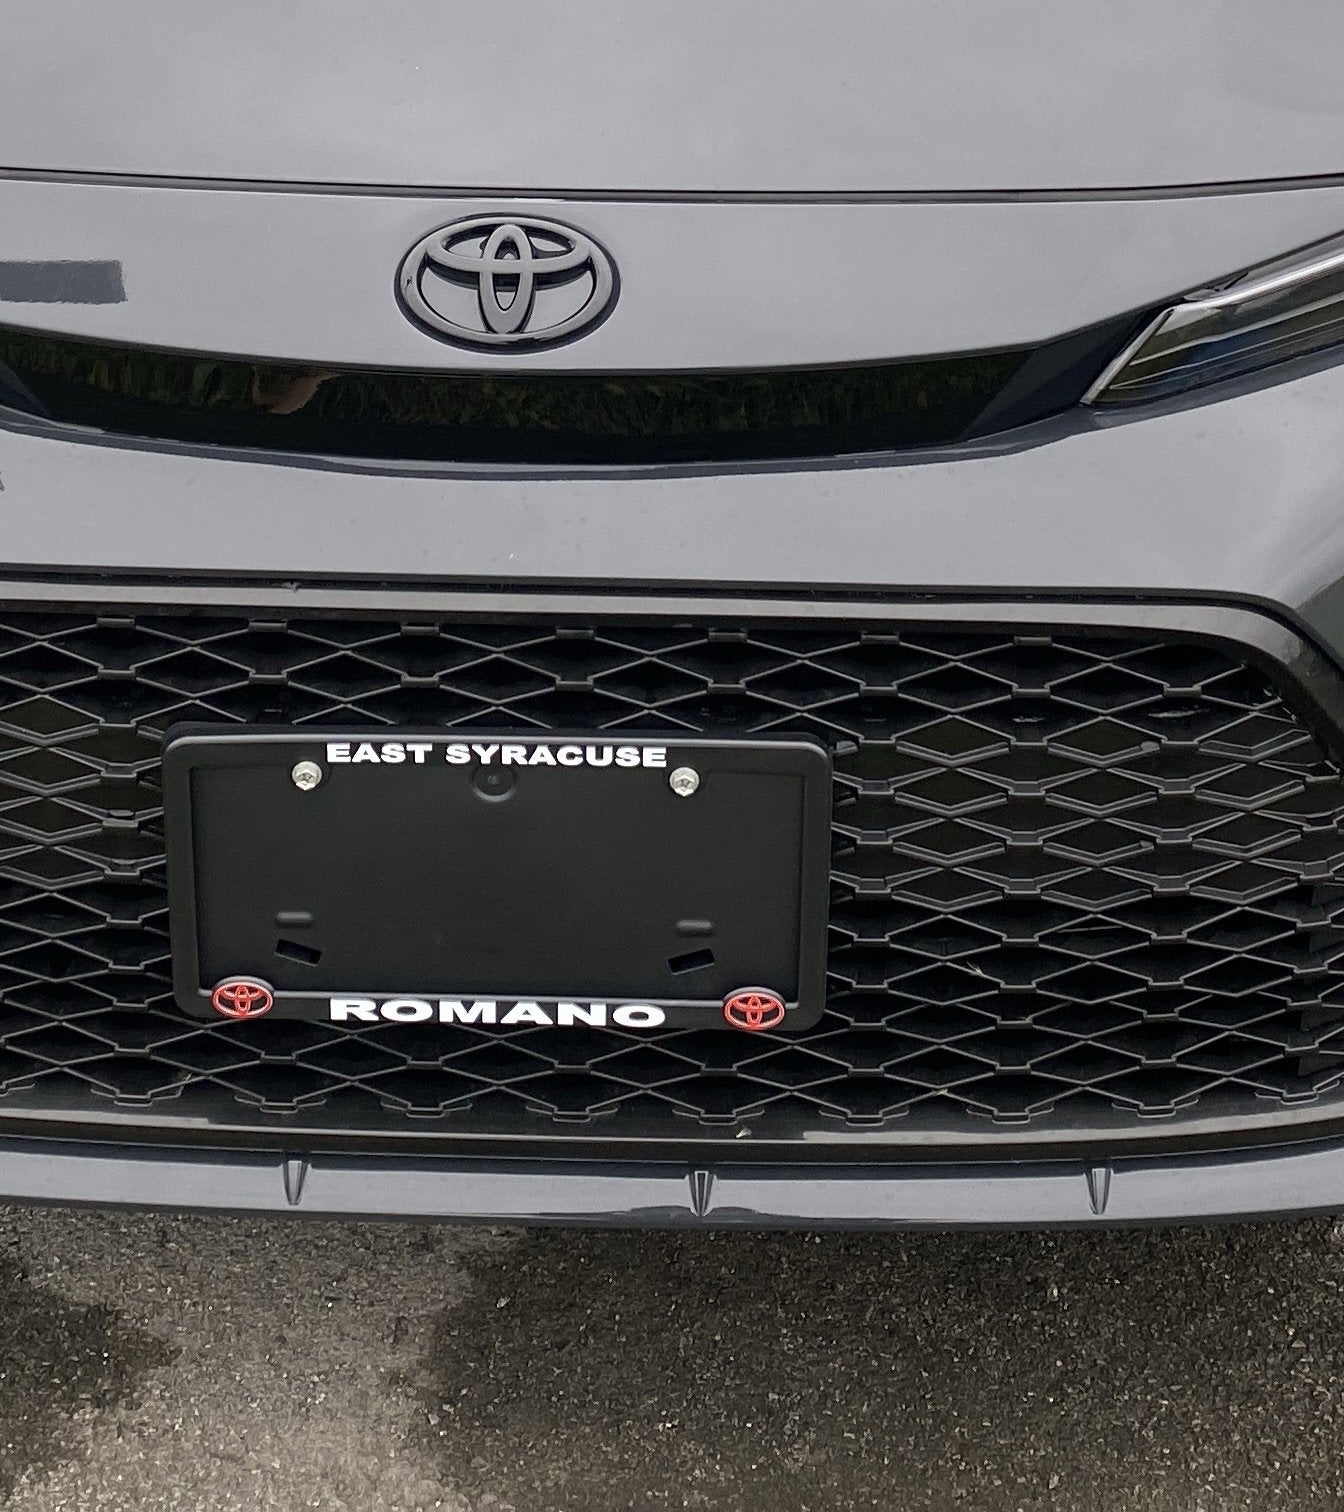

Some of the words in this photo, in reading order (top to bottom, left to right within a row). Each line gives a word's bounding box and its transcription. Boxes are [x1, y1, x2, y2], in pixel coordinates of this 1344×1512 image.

[325, 742, 434, 764] EAST
[444, 743, 668, 768] SYRACUSE
[328, 996, 667, 1029] ROMANO
